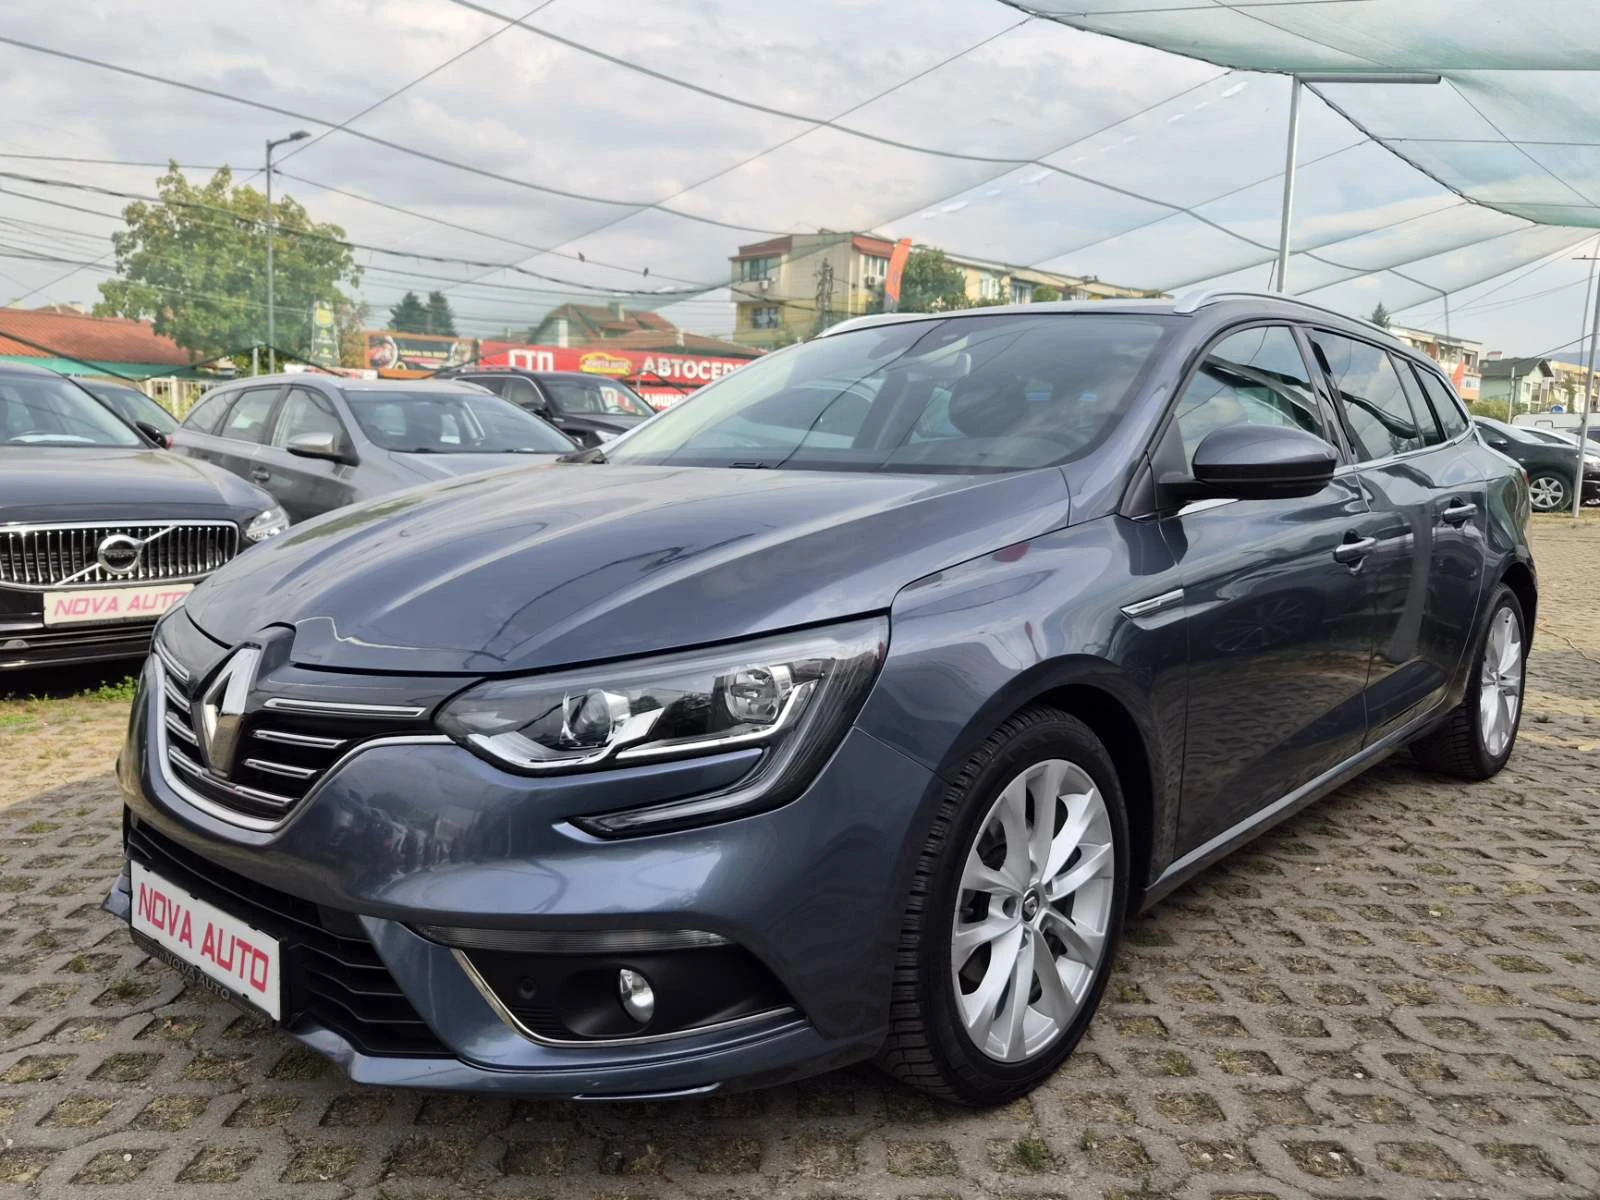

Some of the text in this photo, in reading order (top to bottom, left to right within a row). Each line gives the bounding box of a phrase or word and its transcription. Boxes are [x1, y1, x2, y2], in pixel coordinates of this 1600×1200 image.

[640, 356, 743, 380] АВТОСЕР
[54, 595, 119, 617] NOVA
[138, 882, 193, 949] NOVA
[200, 922, 270, 993] AUTO
[165, 954, 231, 1000] NOVA AUTO
